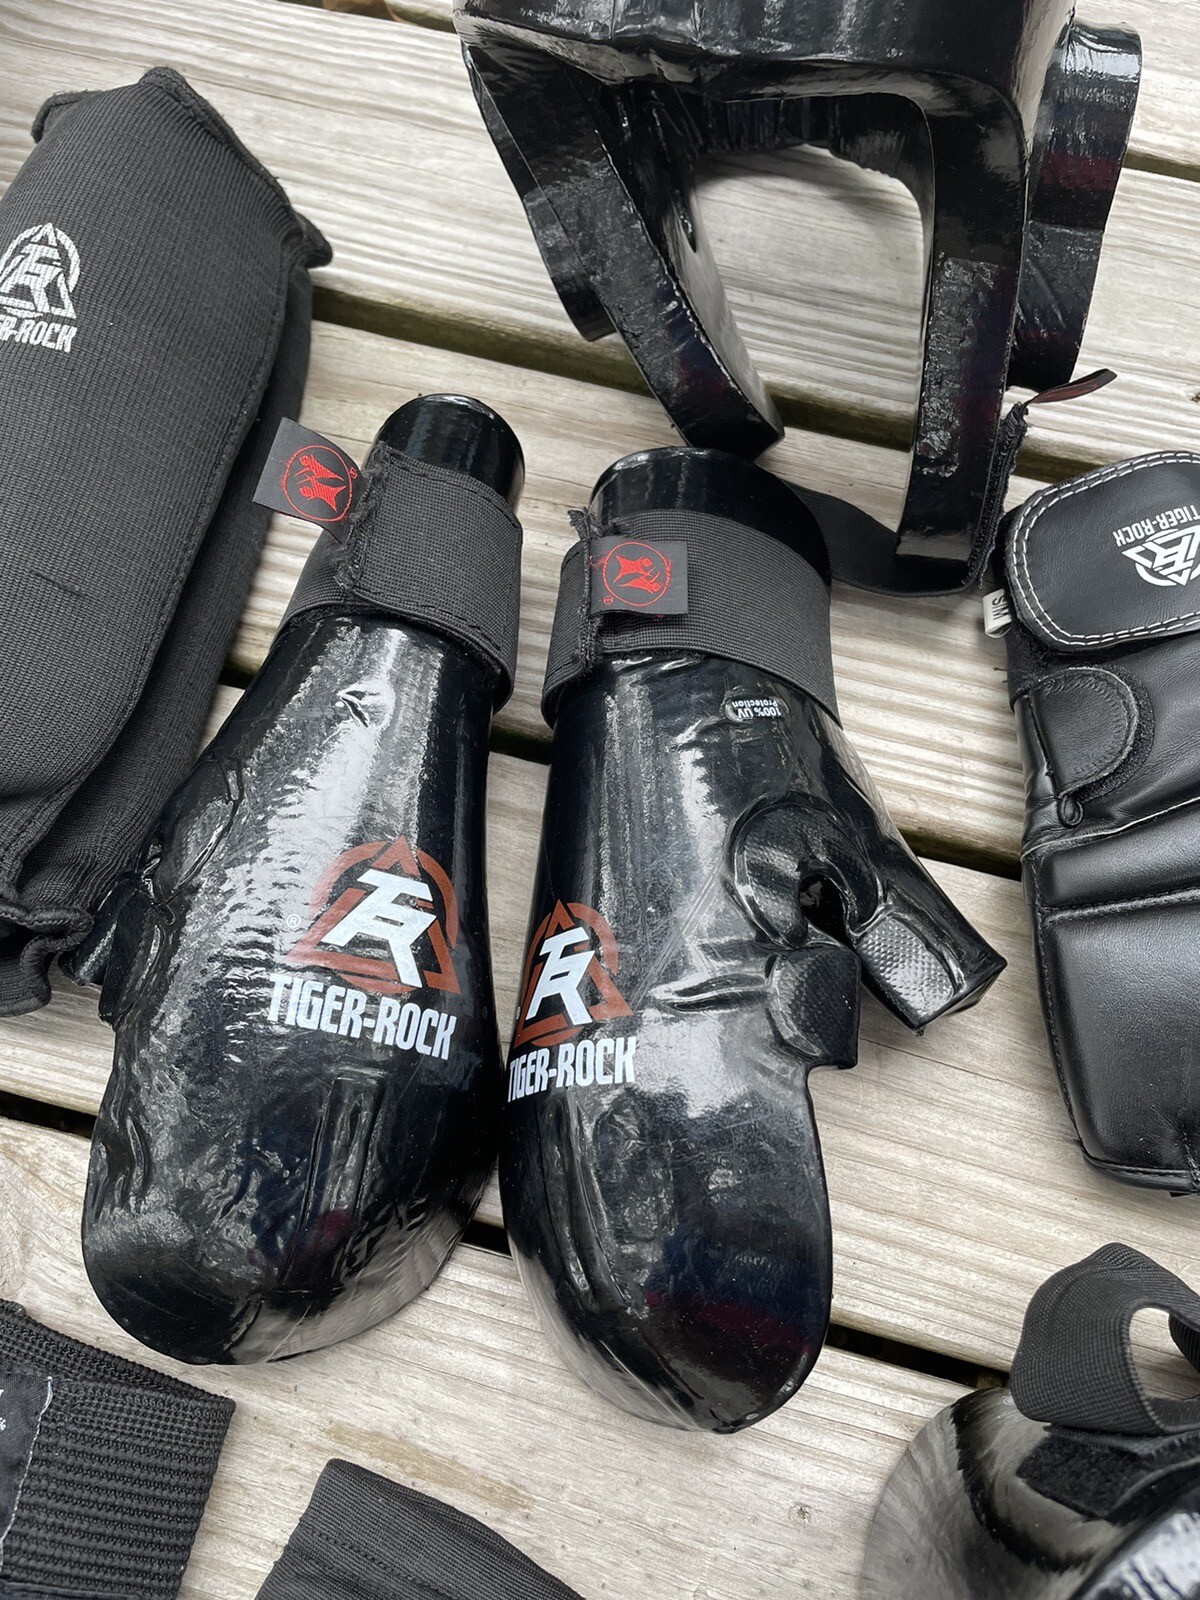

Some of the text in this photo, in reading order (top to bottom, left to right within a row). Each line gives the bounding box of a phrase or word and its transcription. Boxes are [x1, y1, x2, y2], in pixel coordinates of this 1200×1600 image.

[1112, 504, 1200, 547] TIGER-ROCK
[732, 699, 778, 708] Protection
[737, 706, 781, 718] 100% UV
[267, 973, 458, 1061] TIGER-ROCK
[508, 1036, 637, 1103] TIGER-ROCK
